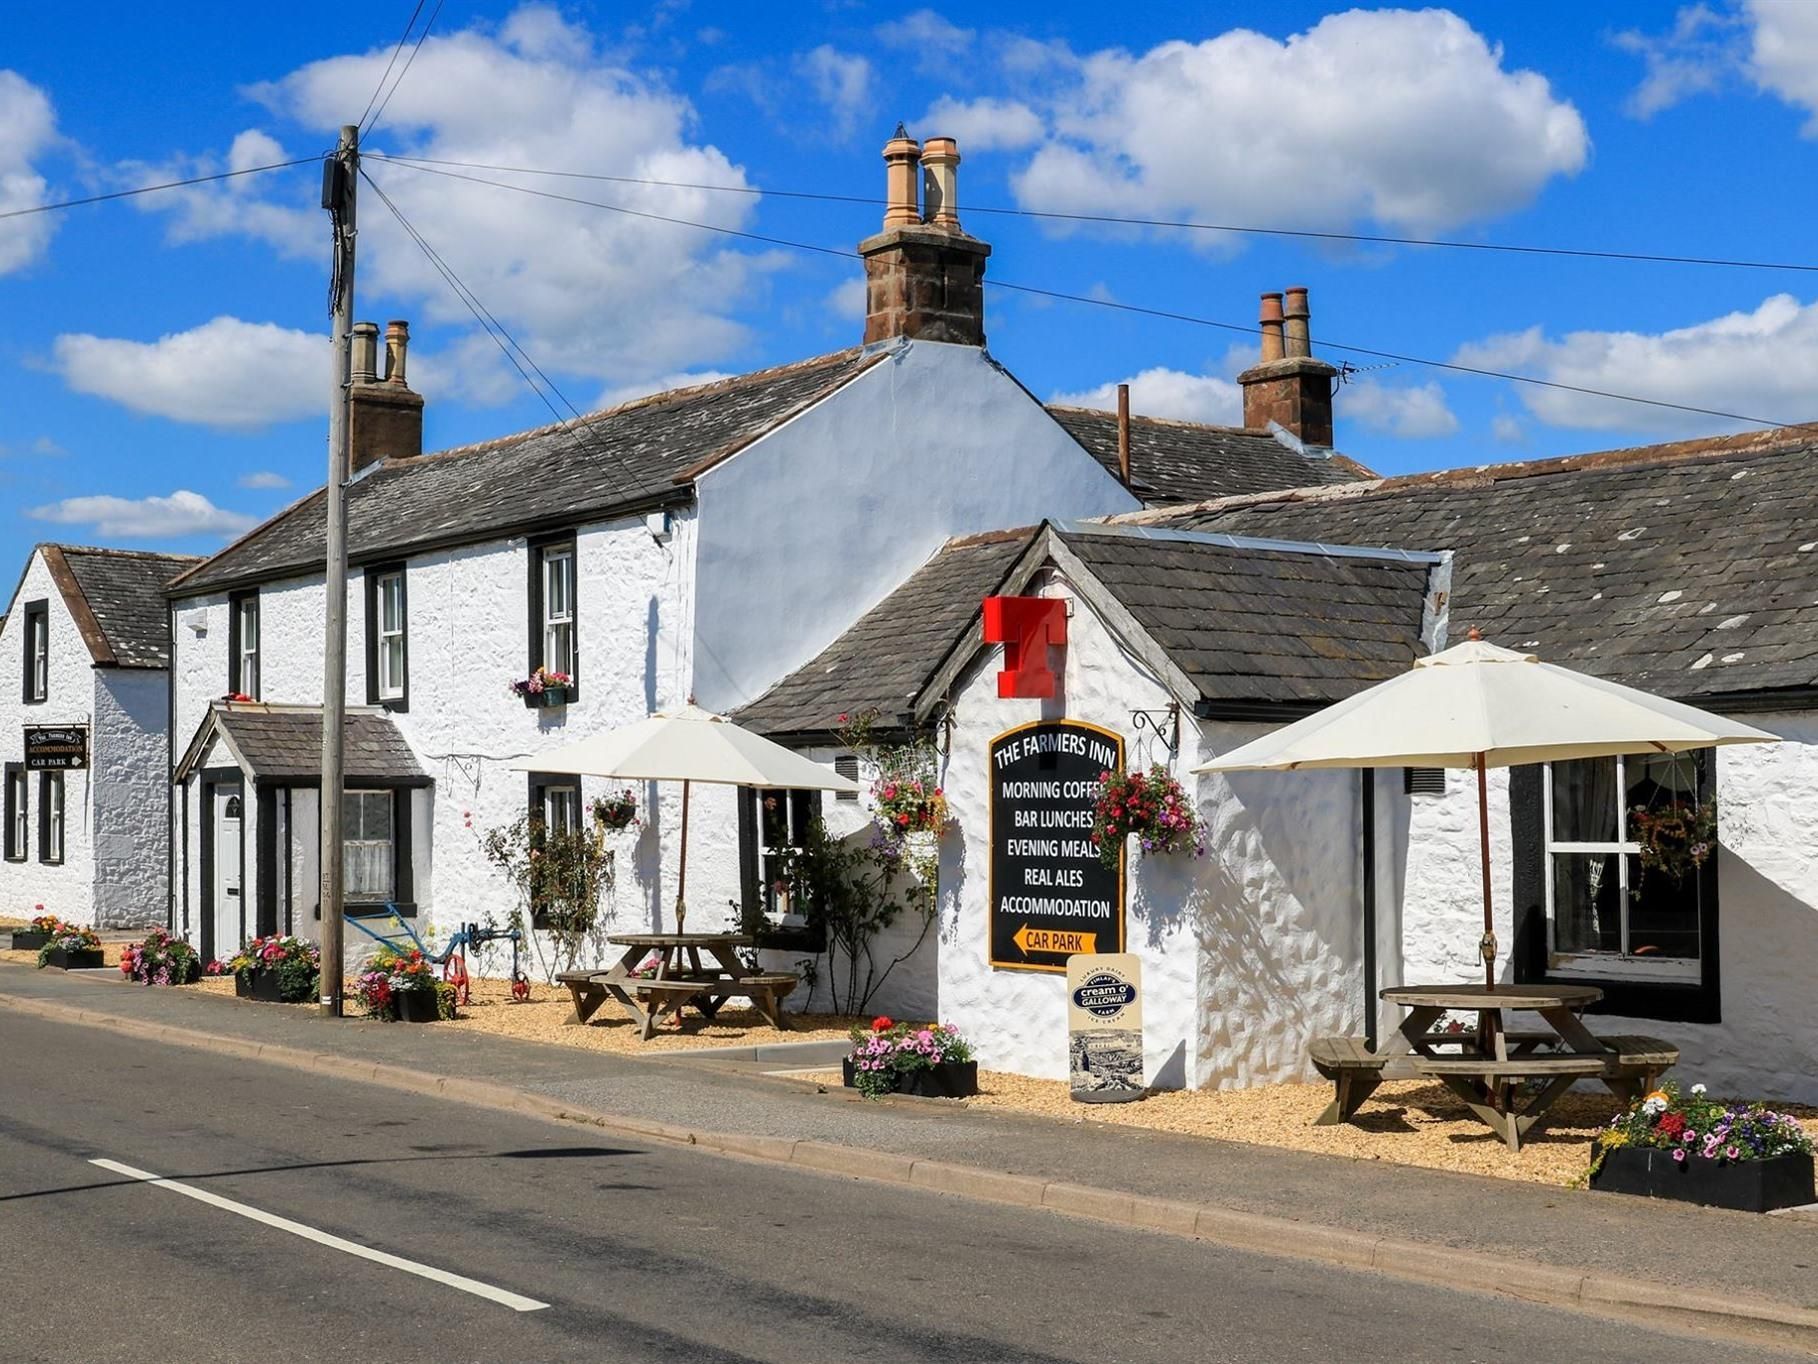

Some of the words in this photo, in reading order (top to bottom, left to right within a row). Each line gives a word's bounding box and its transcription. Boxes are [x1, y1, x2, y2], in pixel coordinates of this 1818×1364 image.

[995, 741, 1021, 769] THE
[1023, 733, 1087, 756] FARMERS
[1088, 740, 1116, 769] INN
[31, 758, 46, 766] CAR
[48, 758, 66, 766] PARK
[1002, 781, 1060, 799] MORNING
[1015, 810, 1038, 828] BAR
[1040, 810, 1094, 828] LUNCHES
[1007, 839, 1058, 857] EVENING
[1024, 868, 1053, 886] REAL
[1055, 869, 1084, 888] ALES
[1000, 896, 1110, 918] ACCOMMODATION
[1026, 931, 1049, 949] CAR
[1052, 933, 1082, 951] PARK
[1081, 987, 1116, 996] cream
[1081, 995, 1127, 1006] GALLOWAY
